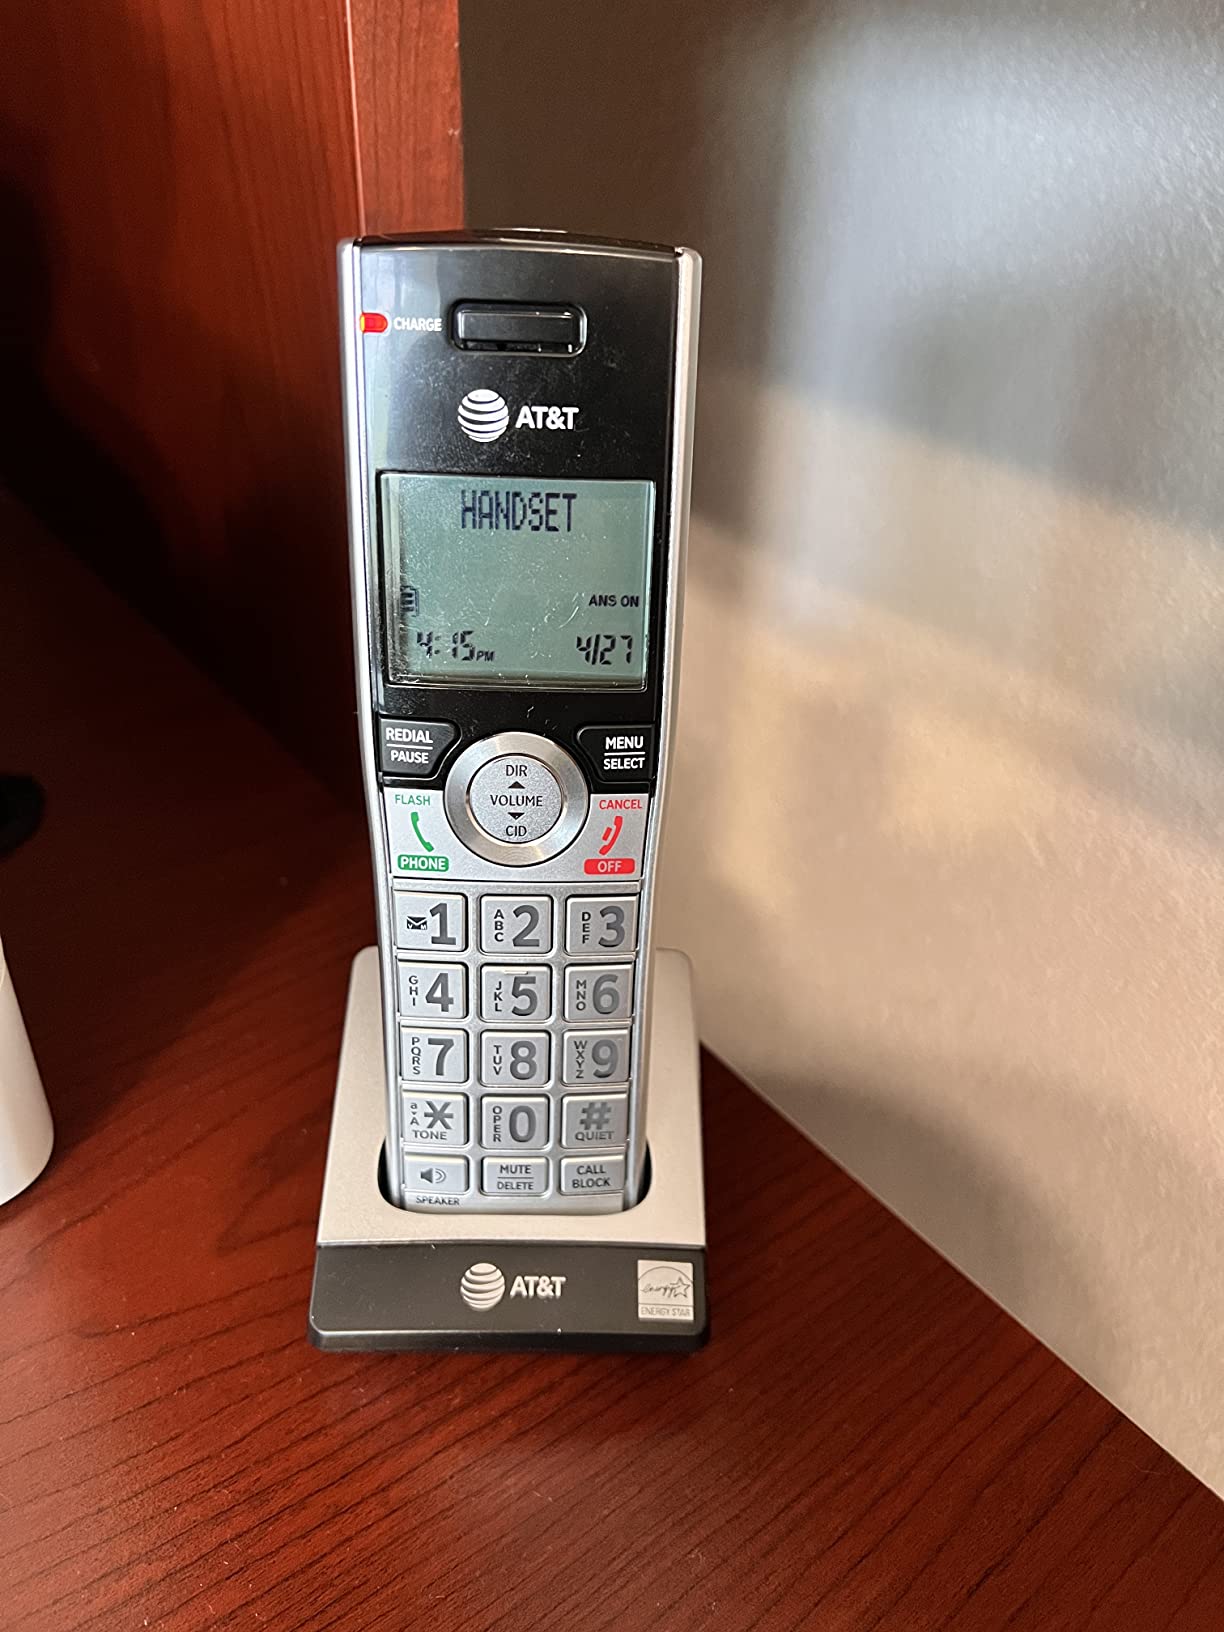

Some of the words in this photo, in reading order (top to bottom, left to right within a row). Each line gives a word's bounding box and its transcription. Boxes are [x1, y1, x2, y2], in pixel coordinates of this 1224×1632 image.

[393, 317, 442, 332] CHARGE
[515, 407, 579, 430] AT&T
[461, 490, 577, 532] HANDSET
[589, 595, 617, 607] ANS
[621, 595, 639, 607] ON
[576, 634, 632, 665] 4/27
[385, 727, 433, 744] REDIAL
[605, 736, 644, 749] MENU
[391, 751, 429, 764] PAUSE
[603, 758, 645, 770] SELECT
[506, 765, 527, 777] DIR
[395, 794, 431, 805] FLASH
[490, 795, 543, 807] VOLUME
[599, 800, 642, 810] CANCEL
[506, 825, 527, 837] CID
[401, 857, 447, 870] PHONE
[598, 861, 622, 872] OFF
[429, 903, 456, 945] 1
[512, 905, 540, 947] 2
[598, 906, 625, 948] 3
[425, 973, 454, 1012] 4
[511, 976, 538, 1016] 5
[592, 974, 620, 1015] 6
[427, 1038, 454, 1076] 7
[510, 1041, 537, 1080] 8
[592, 1040, 619, 1078] 9
[580, 1102, 611, 1130] #
[509, 1105, 536, 1143] 0
[412, 1130, 447, 1140] TONE
[574, 1131, 615, 1141] QUIET
[500, 1165, 531, 1174] MUTE
[577, 1165, 606, 1175] CALL
[497, 1181, 534, 1190] DELETE
[572, 1178, 611, 1188] BLOCK
[416, 1196, 460, 1206] SPEAKER
[510, 1276, 566, 1299] AT&T
[641, 1307, 669, 1316] ENERGY
[672, 1308, 691, 1317] STAR
